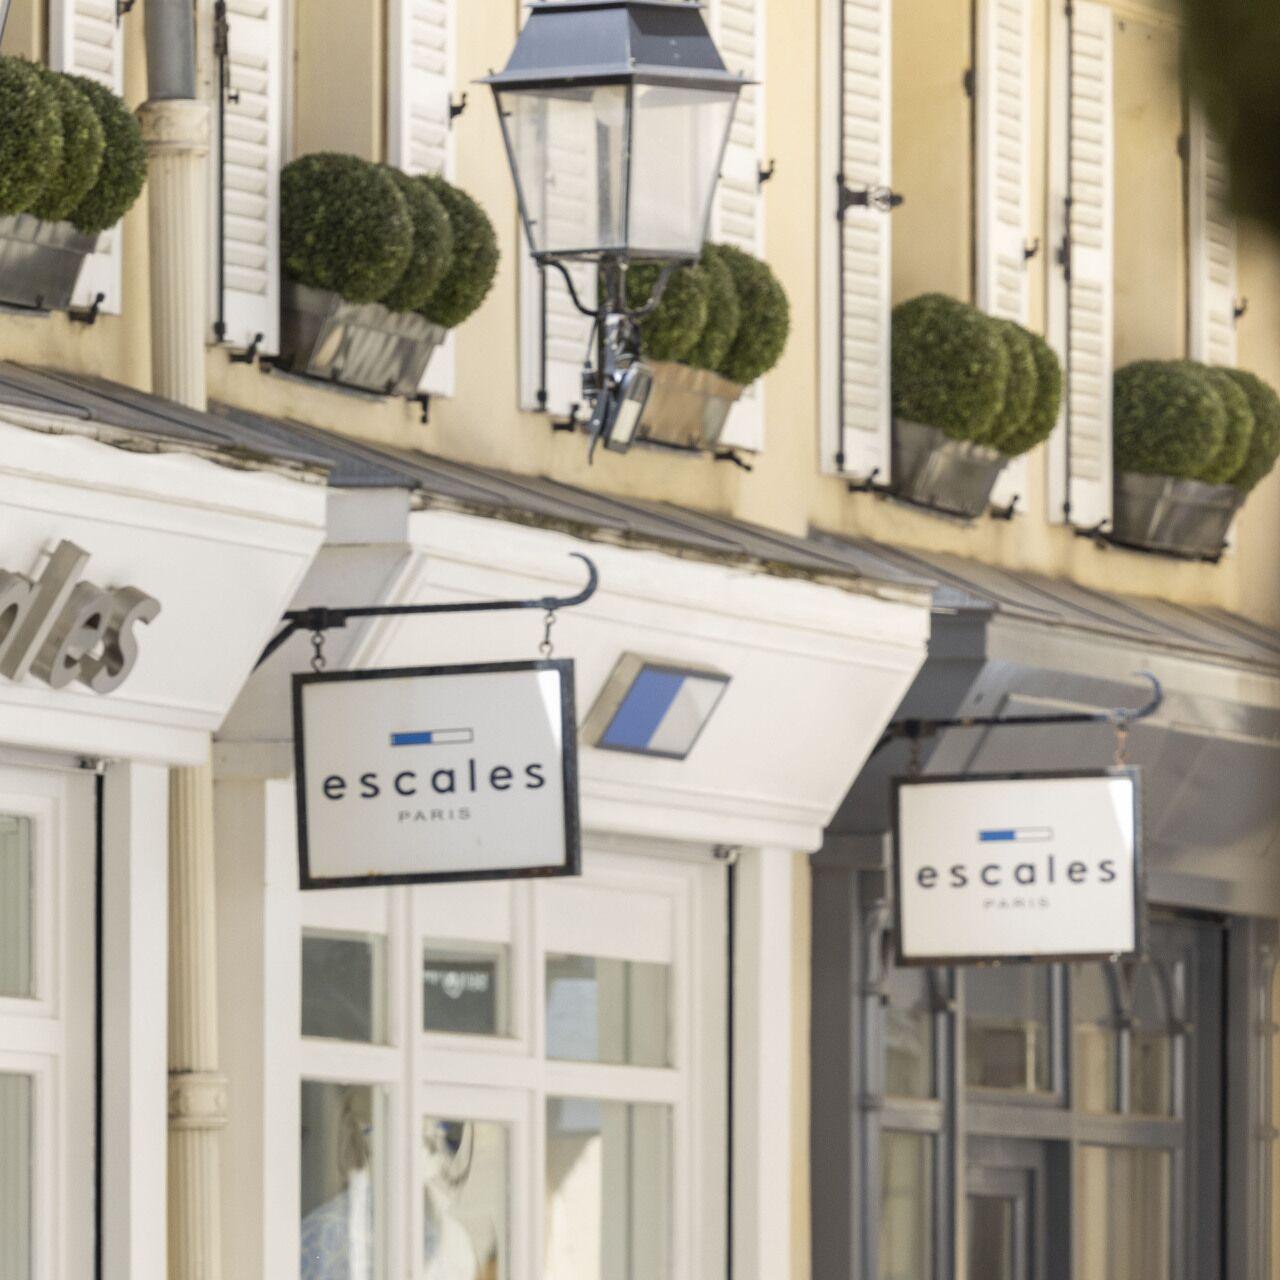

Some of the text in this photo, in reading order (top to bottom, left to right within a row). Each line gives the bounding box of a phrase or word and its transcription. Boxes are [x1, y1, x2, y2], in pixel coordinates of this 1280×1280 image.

[323, 757, 546, 800] escales
[397, 807, 471, 823] PARIS
[916, 854, 1117, 889] escales
